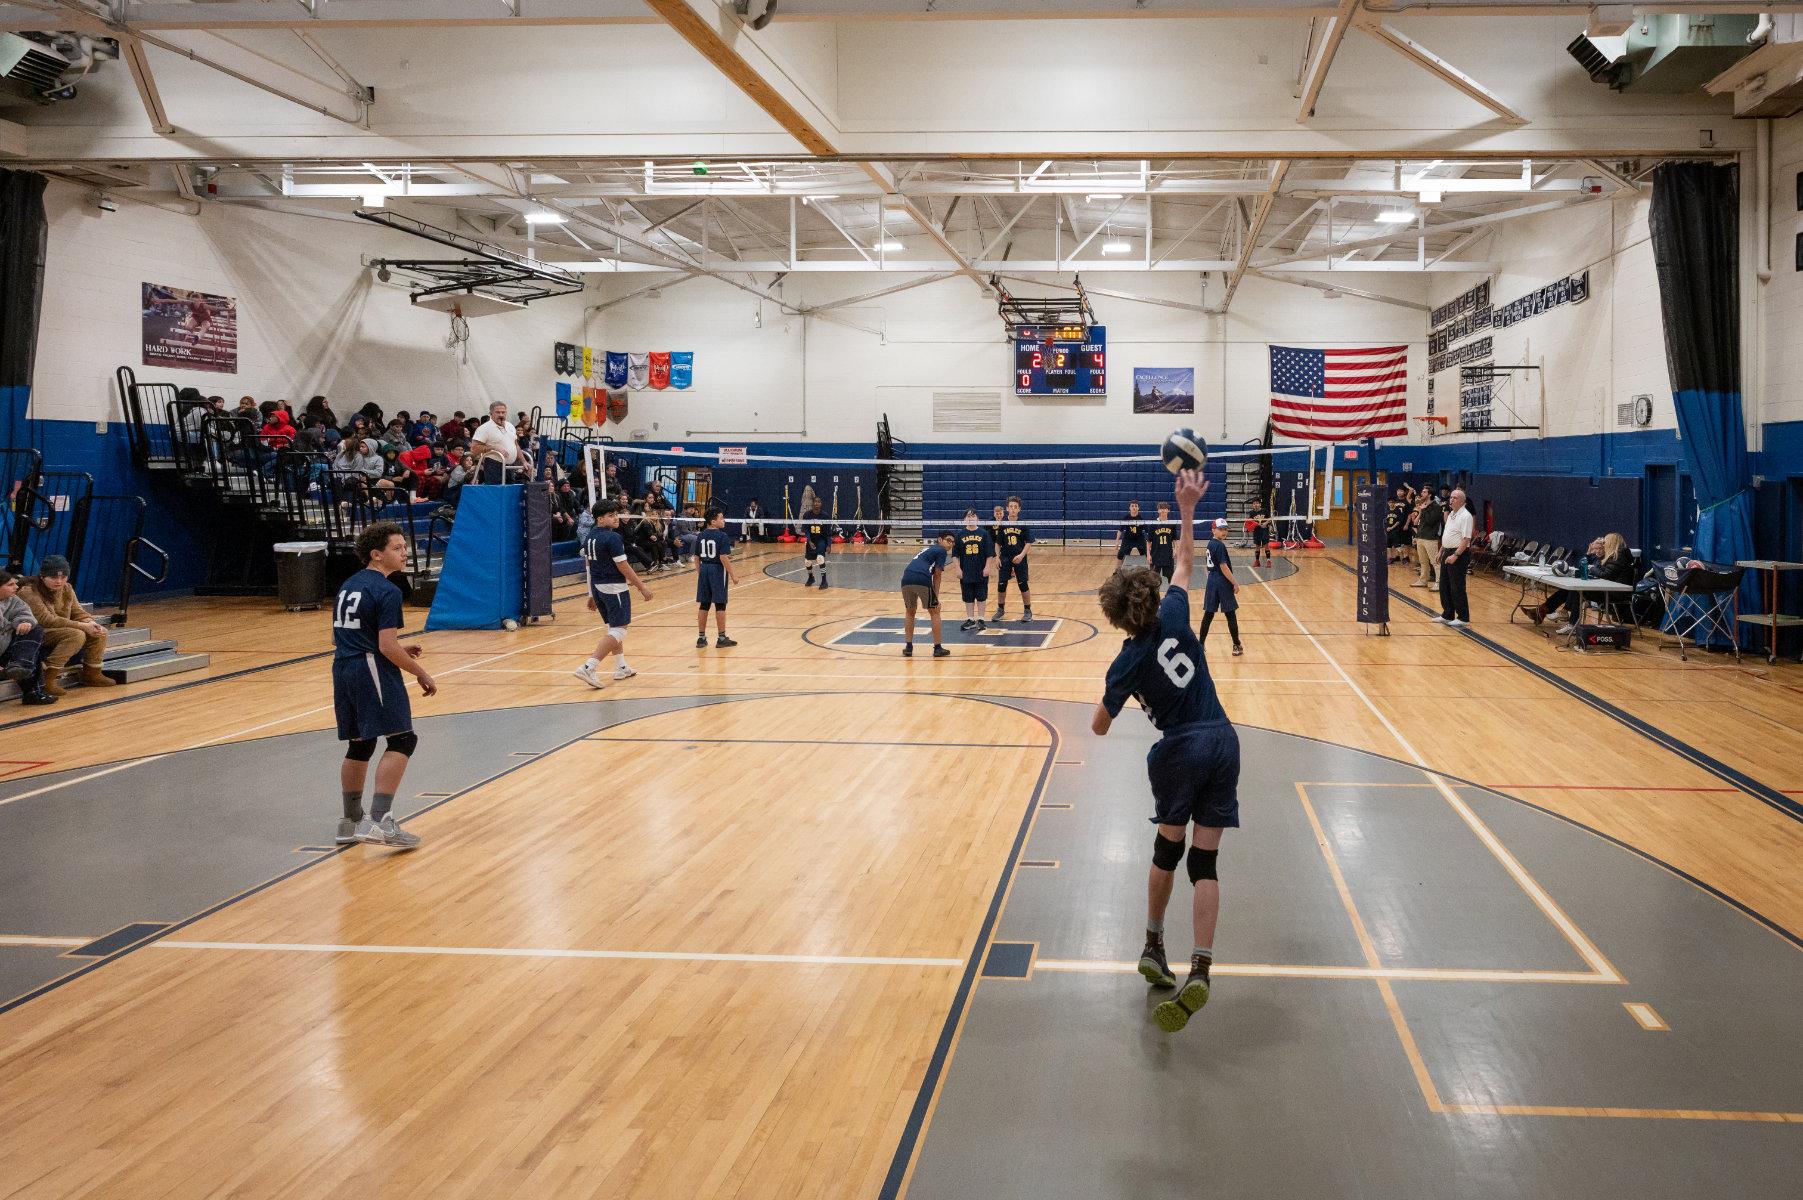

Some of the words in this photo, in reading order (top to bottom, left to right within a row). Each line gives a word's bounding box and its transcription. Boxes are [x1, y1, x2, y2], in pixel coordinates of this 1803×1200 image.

[145, 344, 168, 352] HARD
[170, 347, 192, 355] WORK
[1032, 353, 1041, 368] 2
[1057, 354, 1065, 367] 2
[1094, 354, 1103, 368] 4
[1022, 375, 1030, 386] 0
[1099, 375, 1103, 386] 1
[962, 535, 982, 543] EAGLES
[1160, 536, 1167, 545] 11
[588, 538, 597, 561] 11
[700, 539, 716, 558] 10
[966, 544, 979, 555] 26
[334, 590, 362, 629] 12
[1157, 638, 1195, 688] 6
